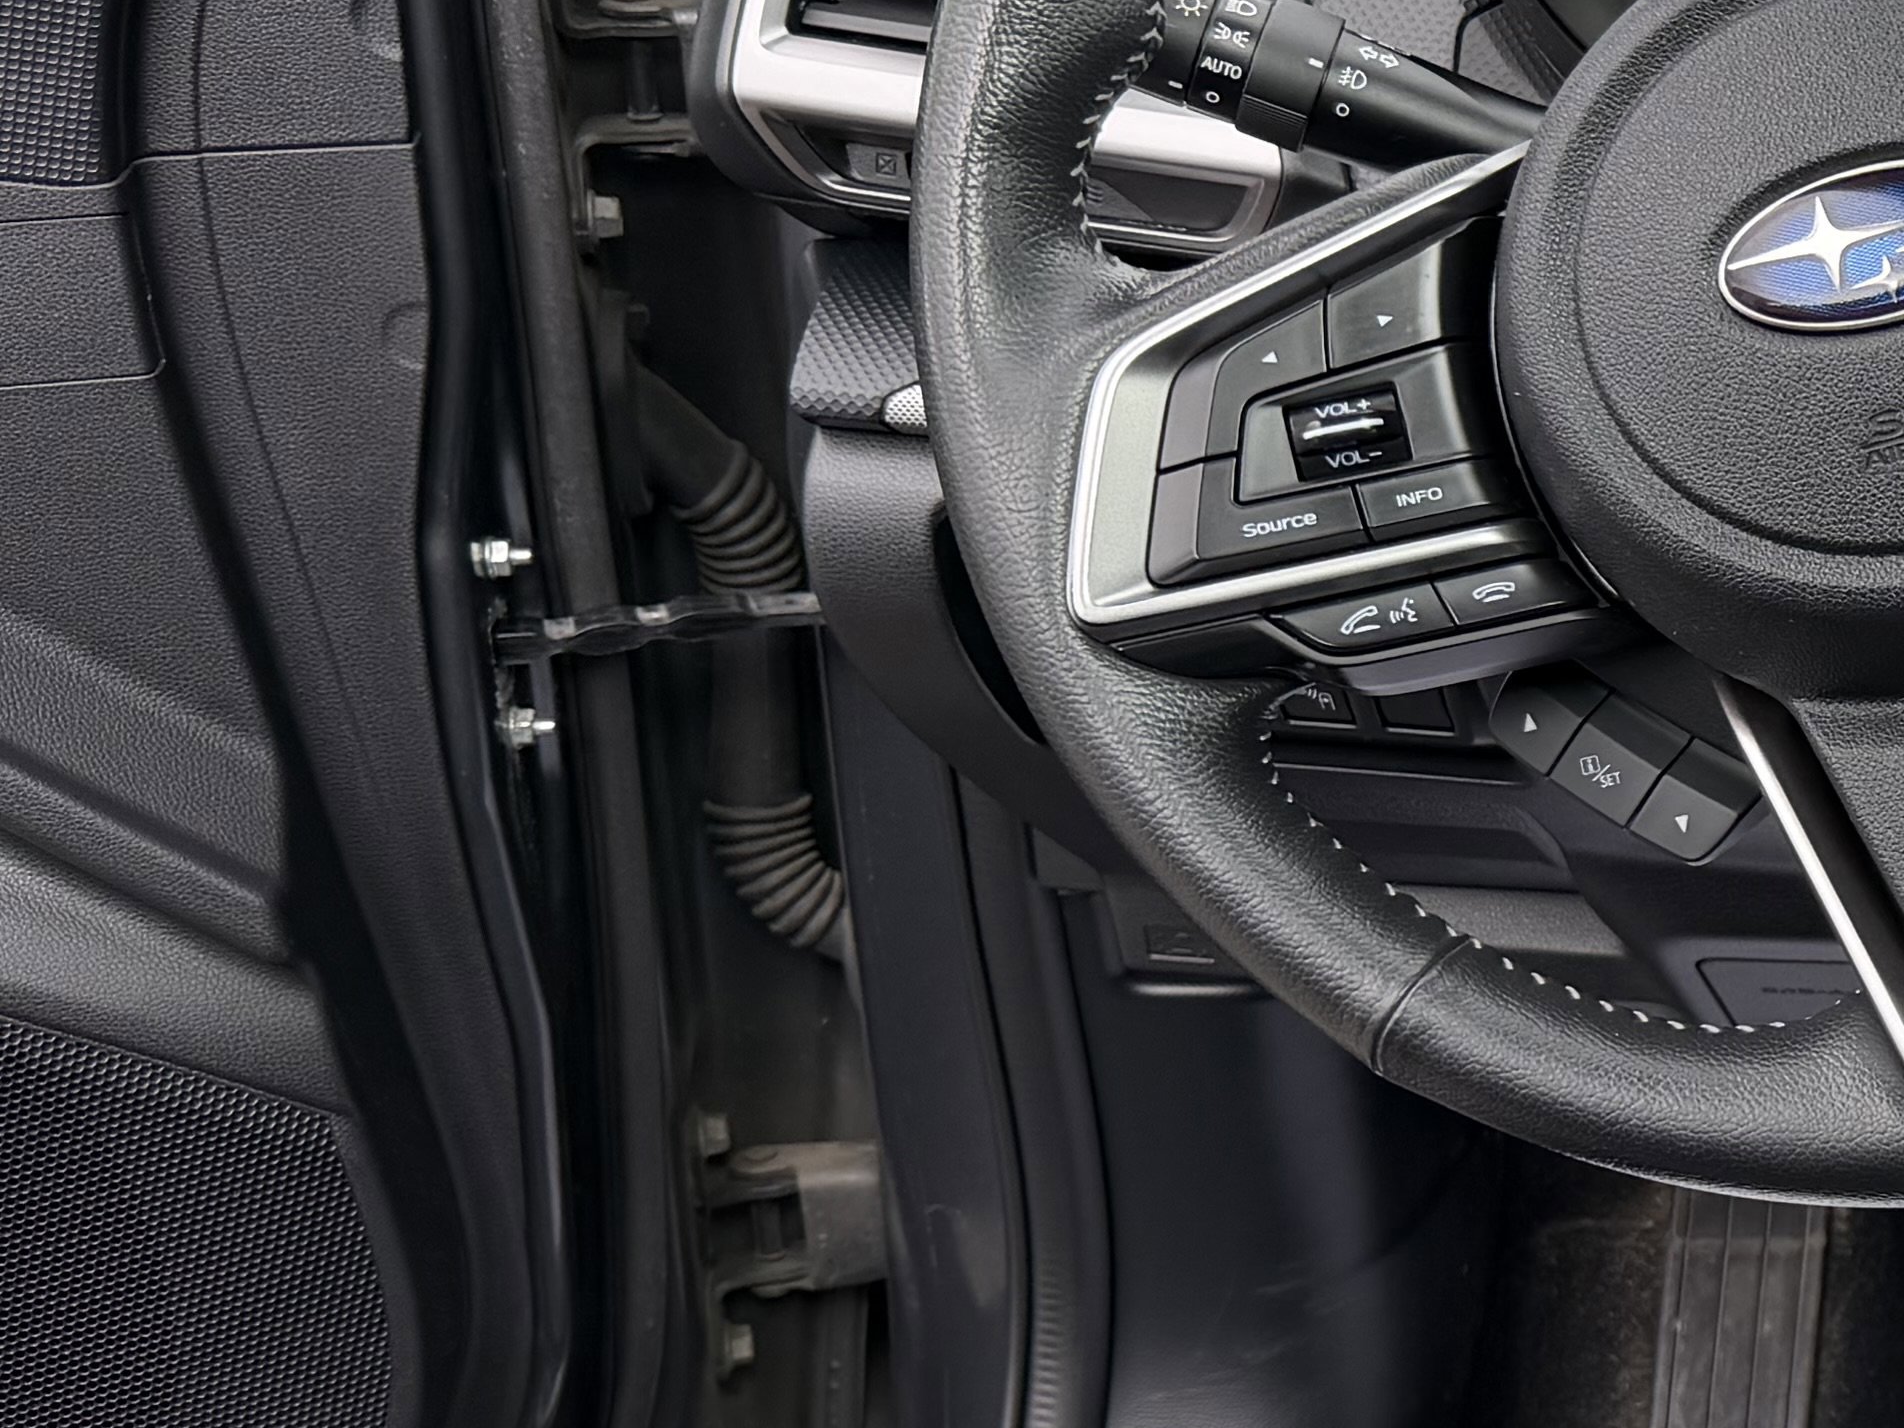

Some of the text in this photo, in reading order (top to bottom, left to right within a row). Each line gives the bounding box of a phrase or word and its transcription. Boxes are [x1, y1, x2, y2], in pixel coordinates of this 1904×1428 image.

[1200, 56, 1242, 80] AUTO
[1396, 487, 1443, 508] INFO
[1242, 512, 1318, 538] Source
